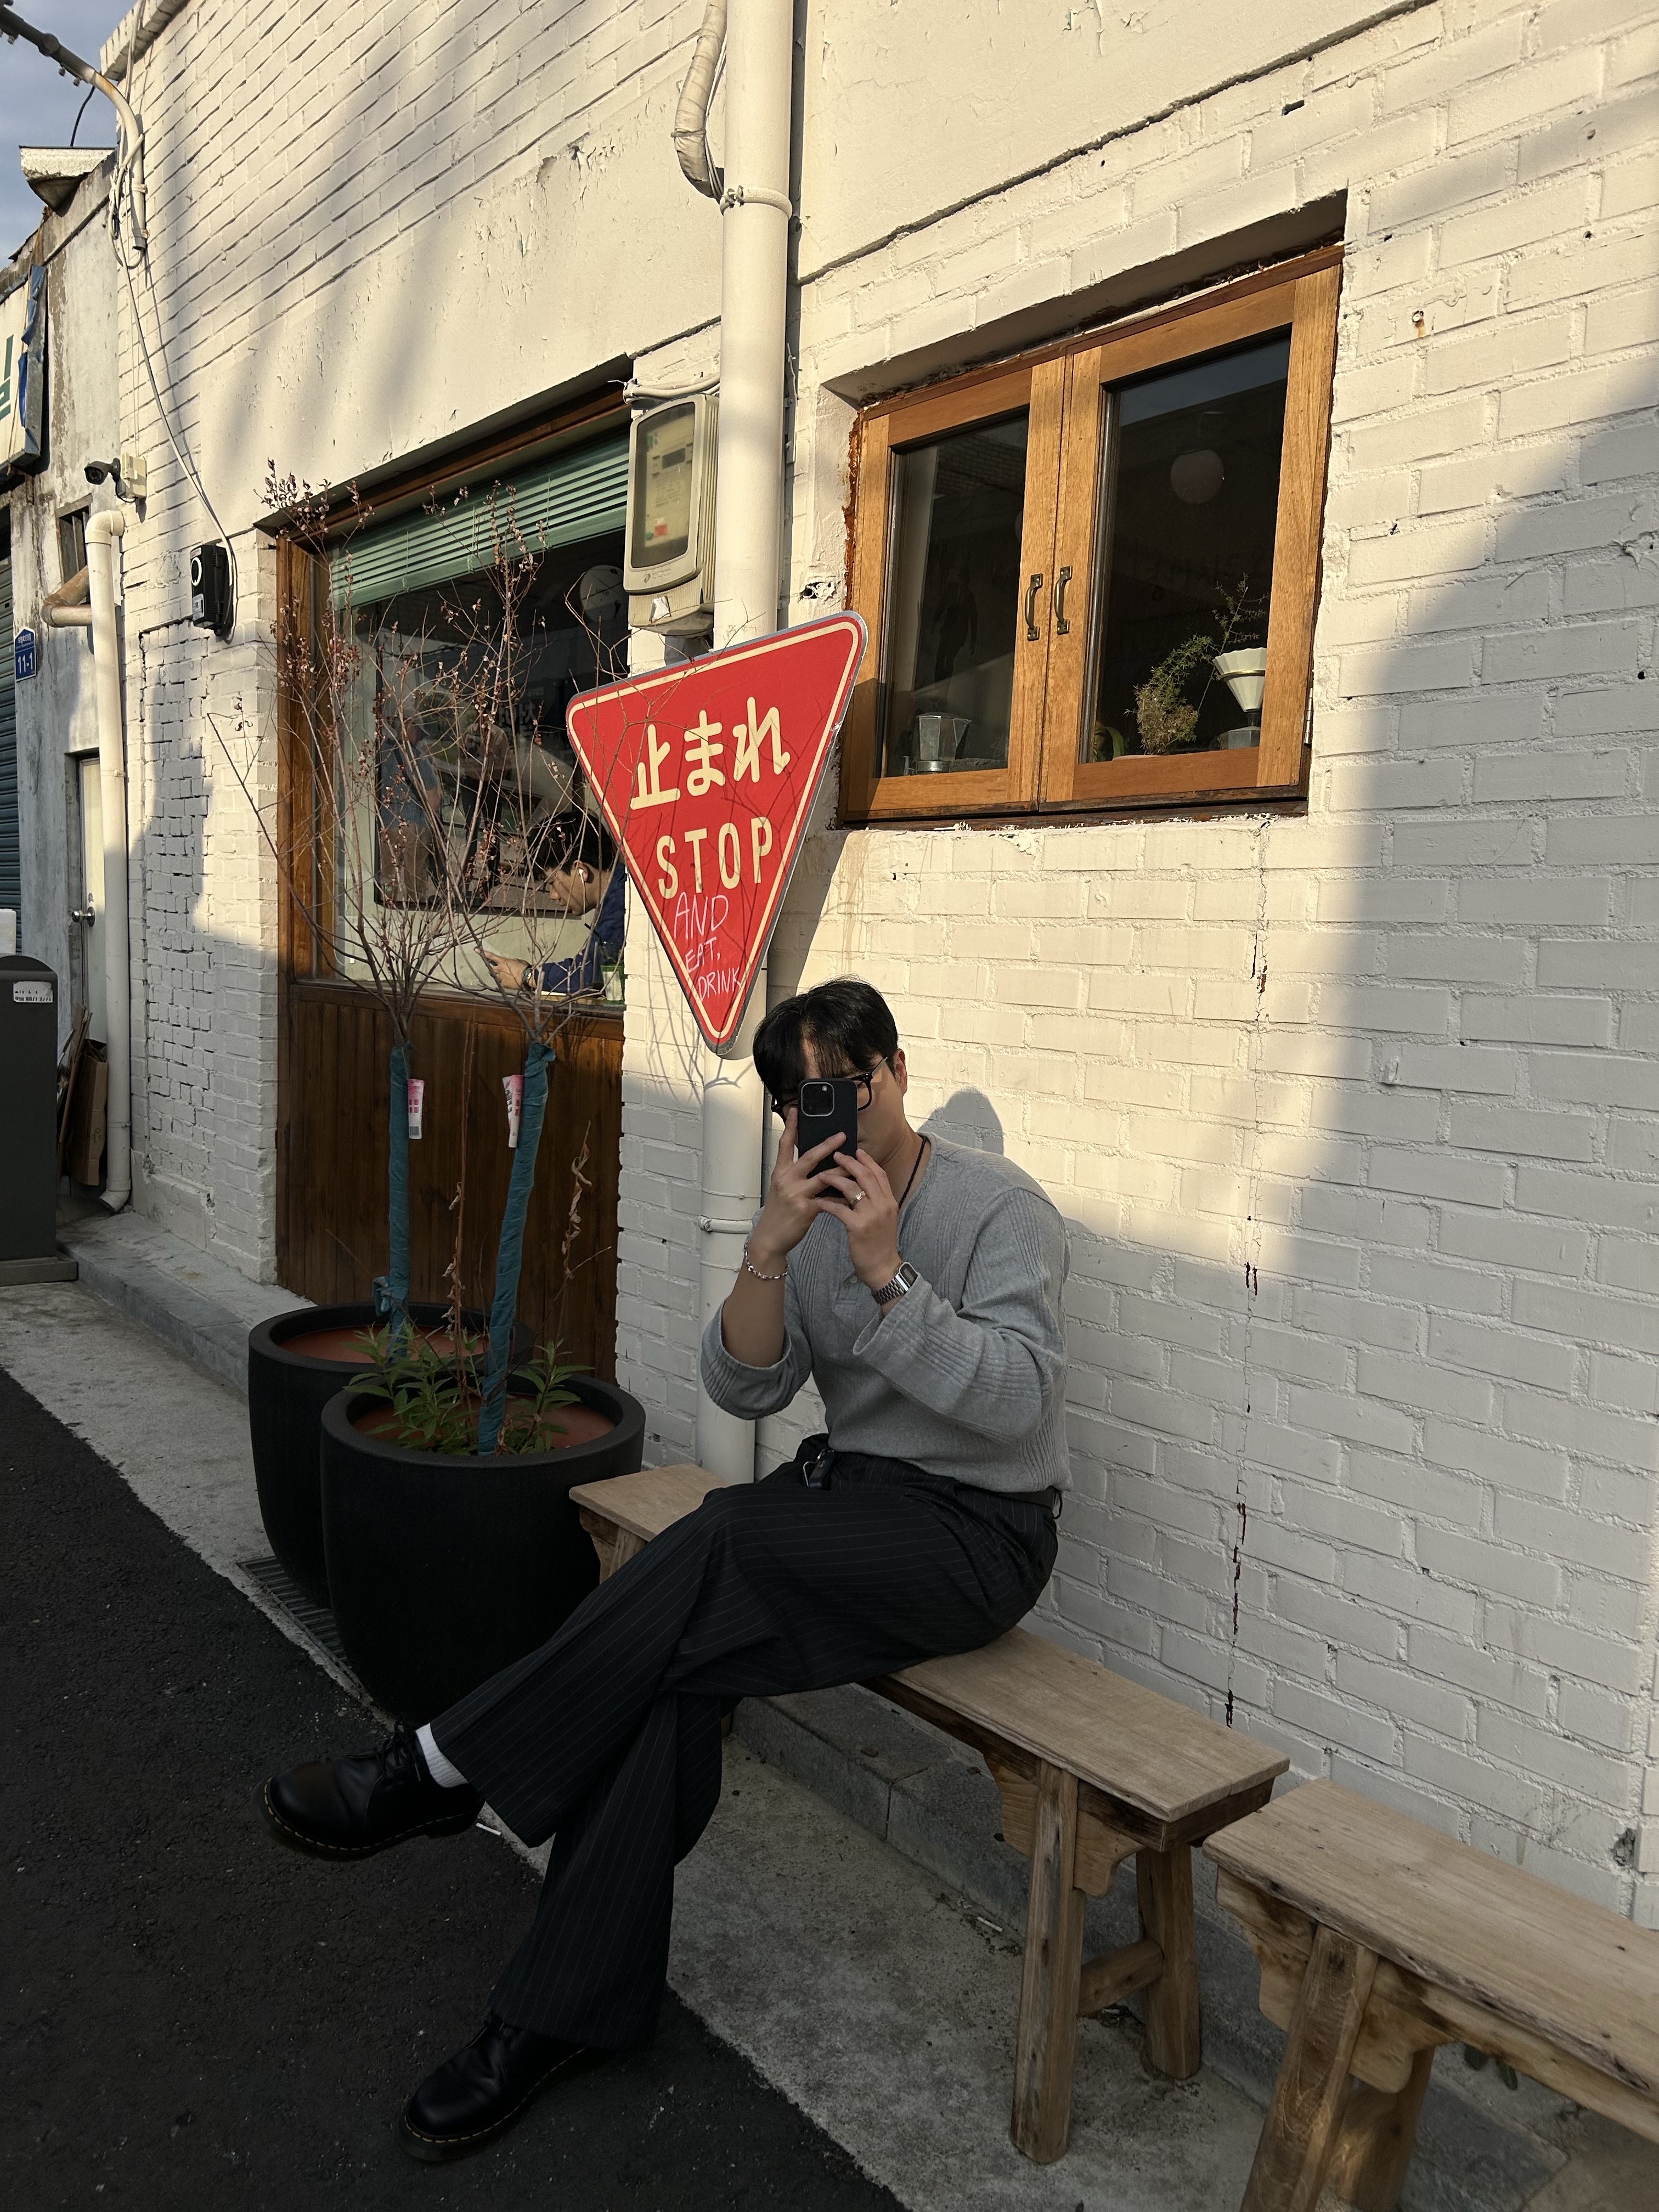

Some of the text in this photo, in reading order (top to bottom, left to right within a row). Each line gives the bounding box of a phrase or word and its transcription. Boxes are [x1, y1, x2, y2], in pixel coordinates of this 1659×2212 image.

[18, 652, 33, 674] 11-1
[630, 696, 791, 810] 止まれ
[656, 816, 773, 900] STOP
[674, 891, 730, 940] AND
[685, 936, 721, 974] EAT,
[698, 967, 742, 1002] DRINK
